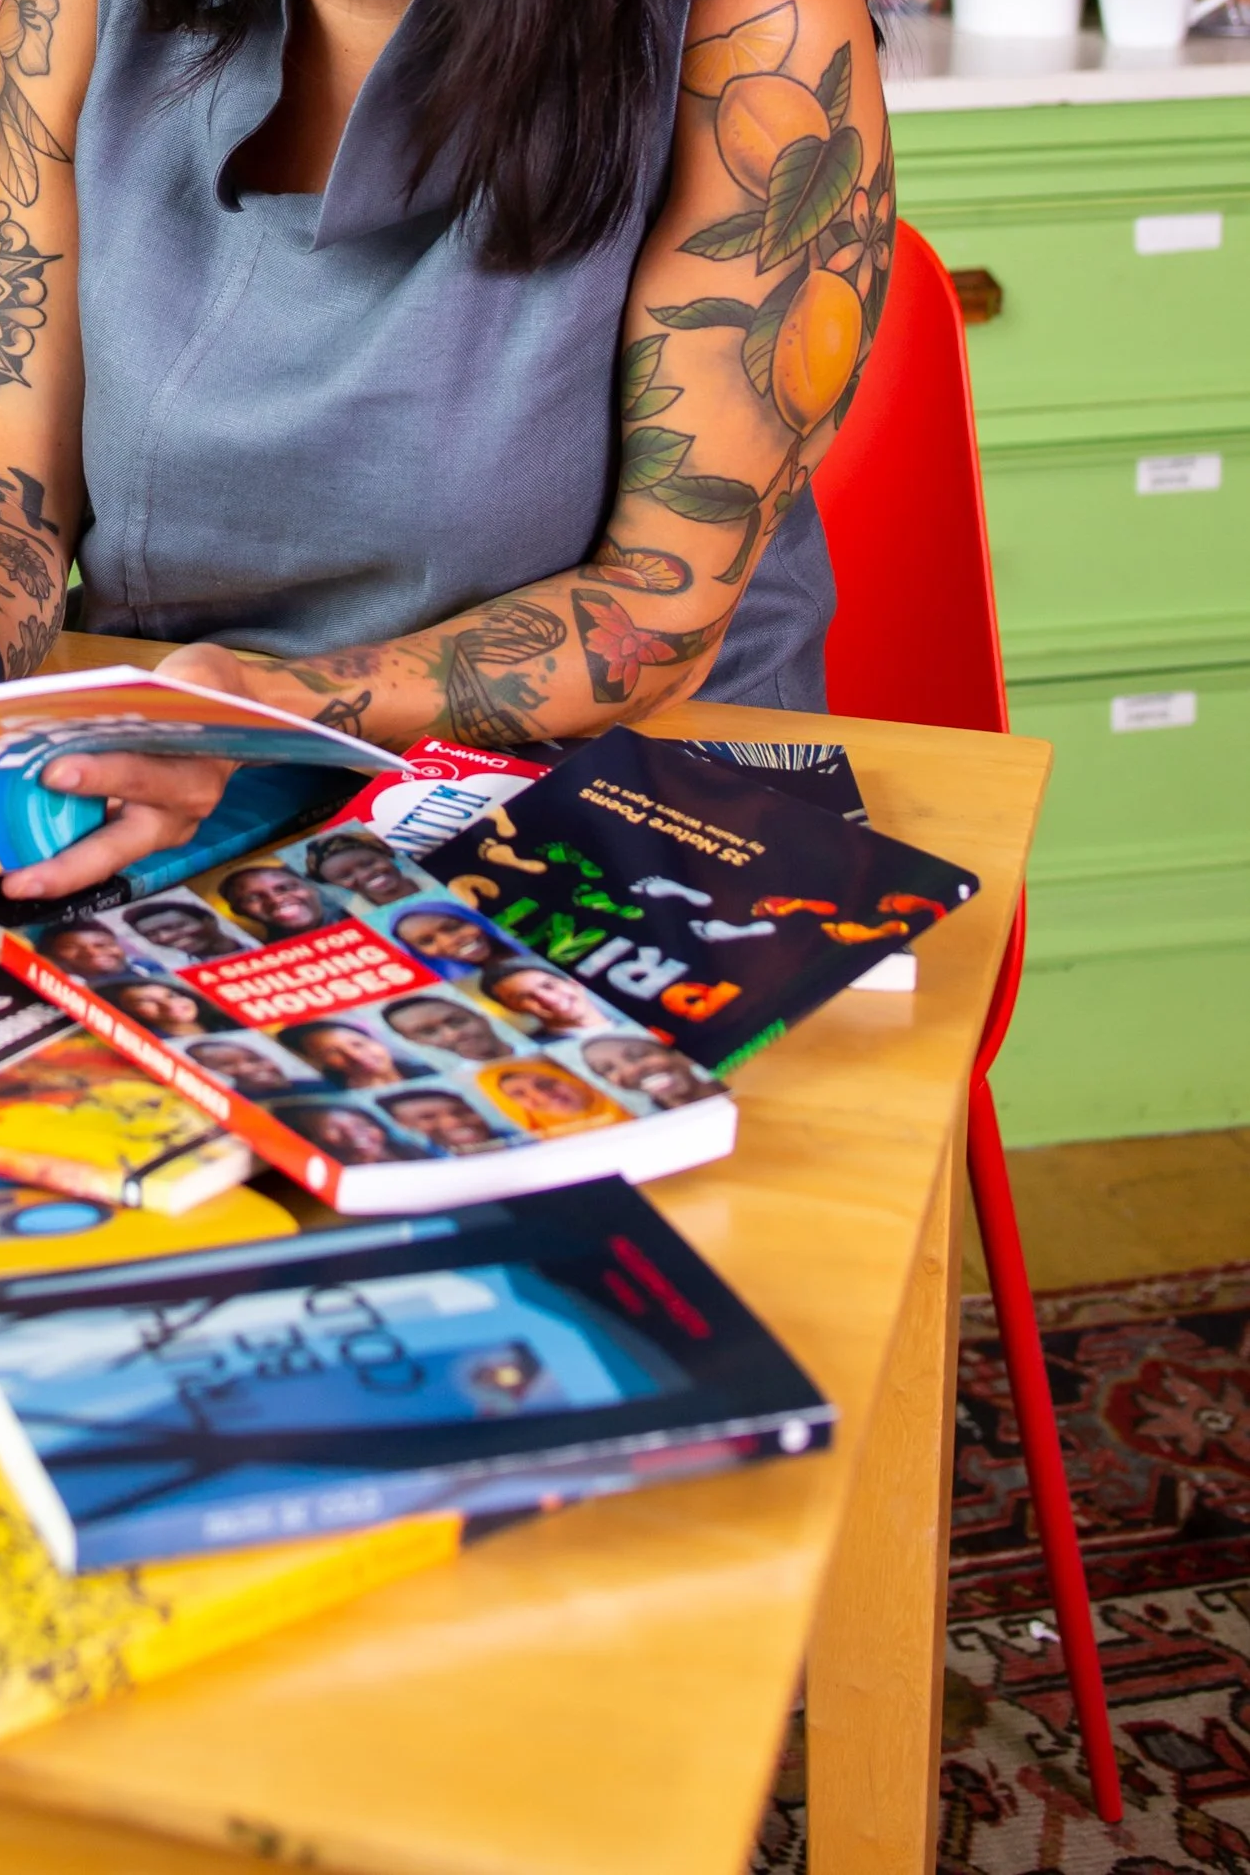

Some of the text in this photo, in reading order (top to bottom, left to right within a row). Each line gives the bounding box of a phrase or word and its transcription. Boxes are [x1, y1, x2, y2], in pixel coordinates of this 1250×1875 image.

[621, 789, 655, 808] Ages
[654, 803, 703, 830] Writers
[579, 788, 751, 867] 35 Nature Poems
[704, 824, 746, 847] Maine
[198, 928, 365, 985] A SEASON FOR
[216, 945, 389, 1002] BUILDING
[240, 963, 415, 1021] HOUSES
[27, 962, 230, 1121] A SEASON FOR BUILDING HOUSES
